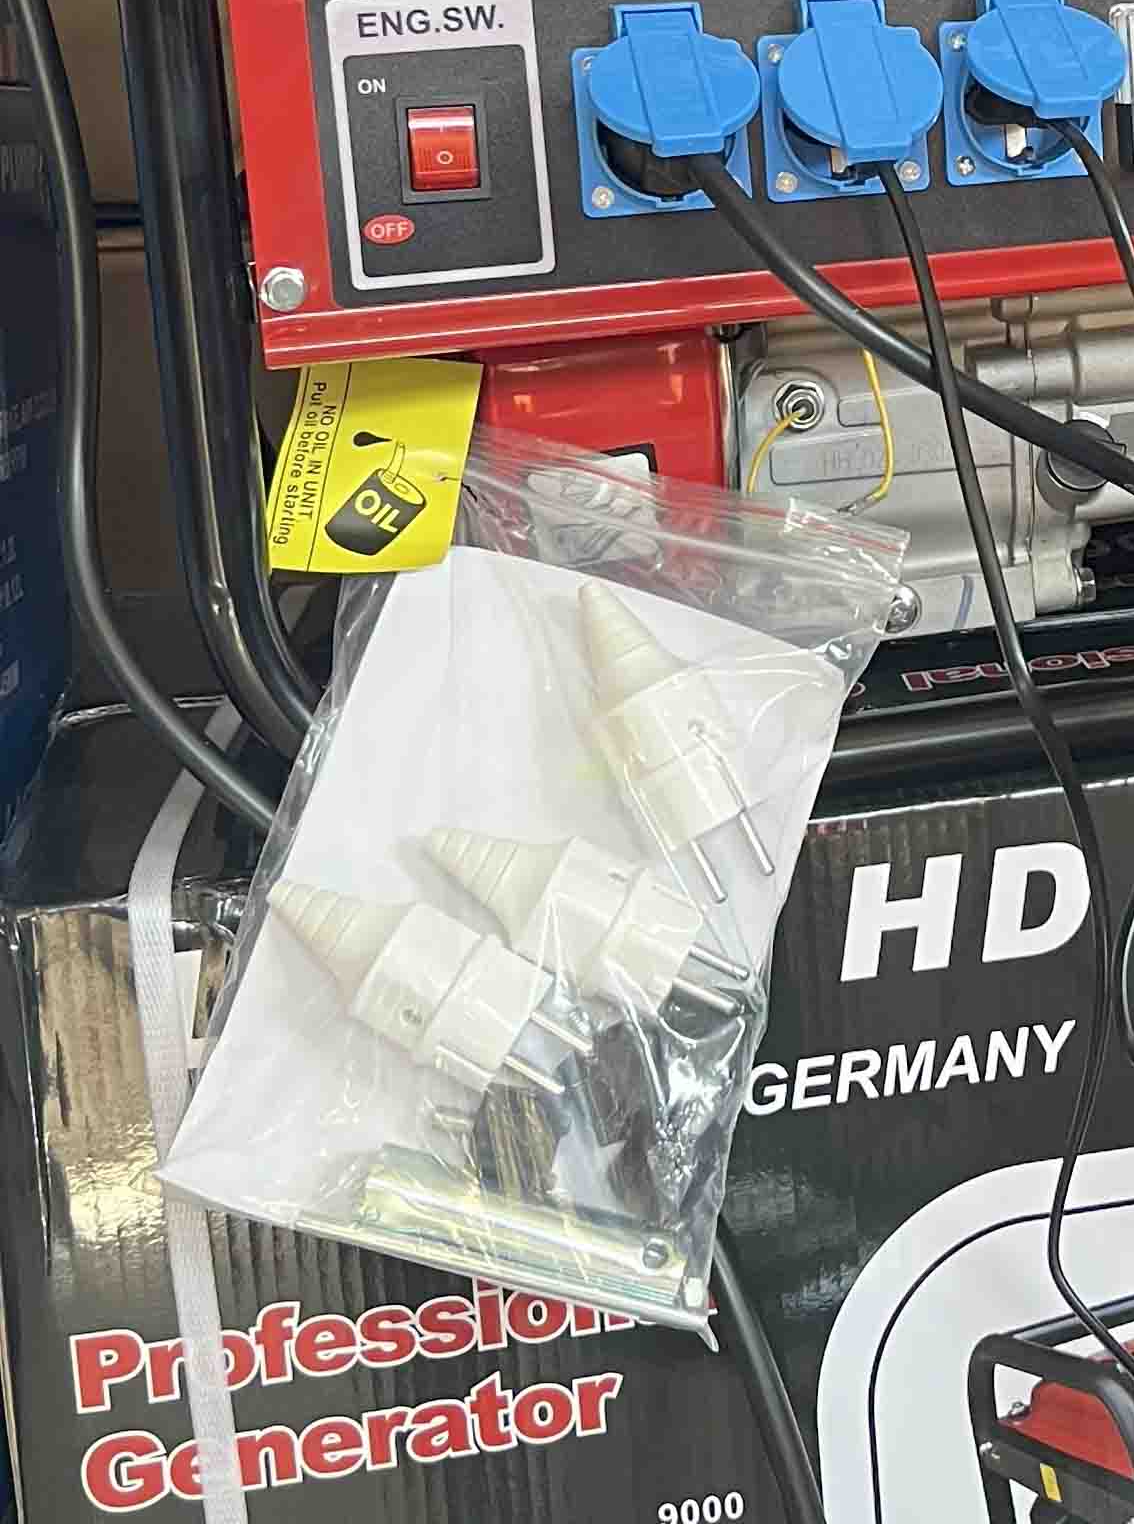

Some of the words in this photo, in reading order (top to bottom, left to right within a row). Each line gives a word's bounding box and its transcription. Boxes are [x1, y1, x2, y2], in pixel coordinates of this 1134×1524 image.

[356, 3, 506, 39] ENG.SW.
[357, 78, 387, 95] ON
[369, 221, 409, 240] OFF
[310, 381, 328, 406] Put
[303, 411, 318, 428] oil
[320, 404, 337, 427] NO
[291, 431, 314, 479] before
[311, 430, 330, 455] OIL
[308, 459, 322, 475] IN
[272, 484, 301, 546] starting
[355, 489, 401, 534] OIL
[840, 841, 1092, 982] HD
[742, 1019, 1077, 1116] GERMANY
[69, 1276, 720, 1414] Prfessio
[656, 1490, 746, 1524] 9000
